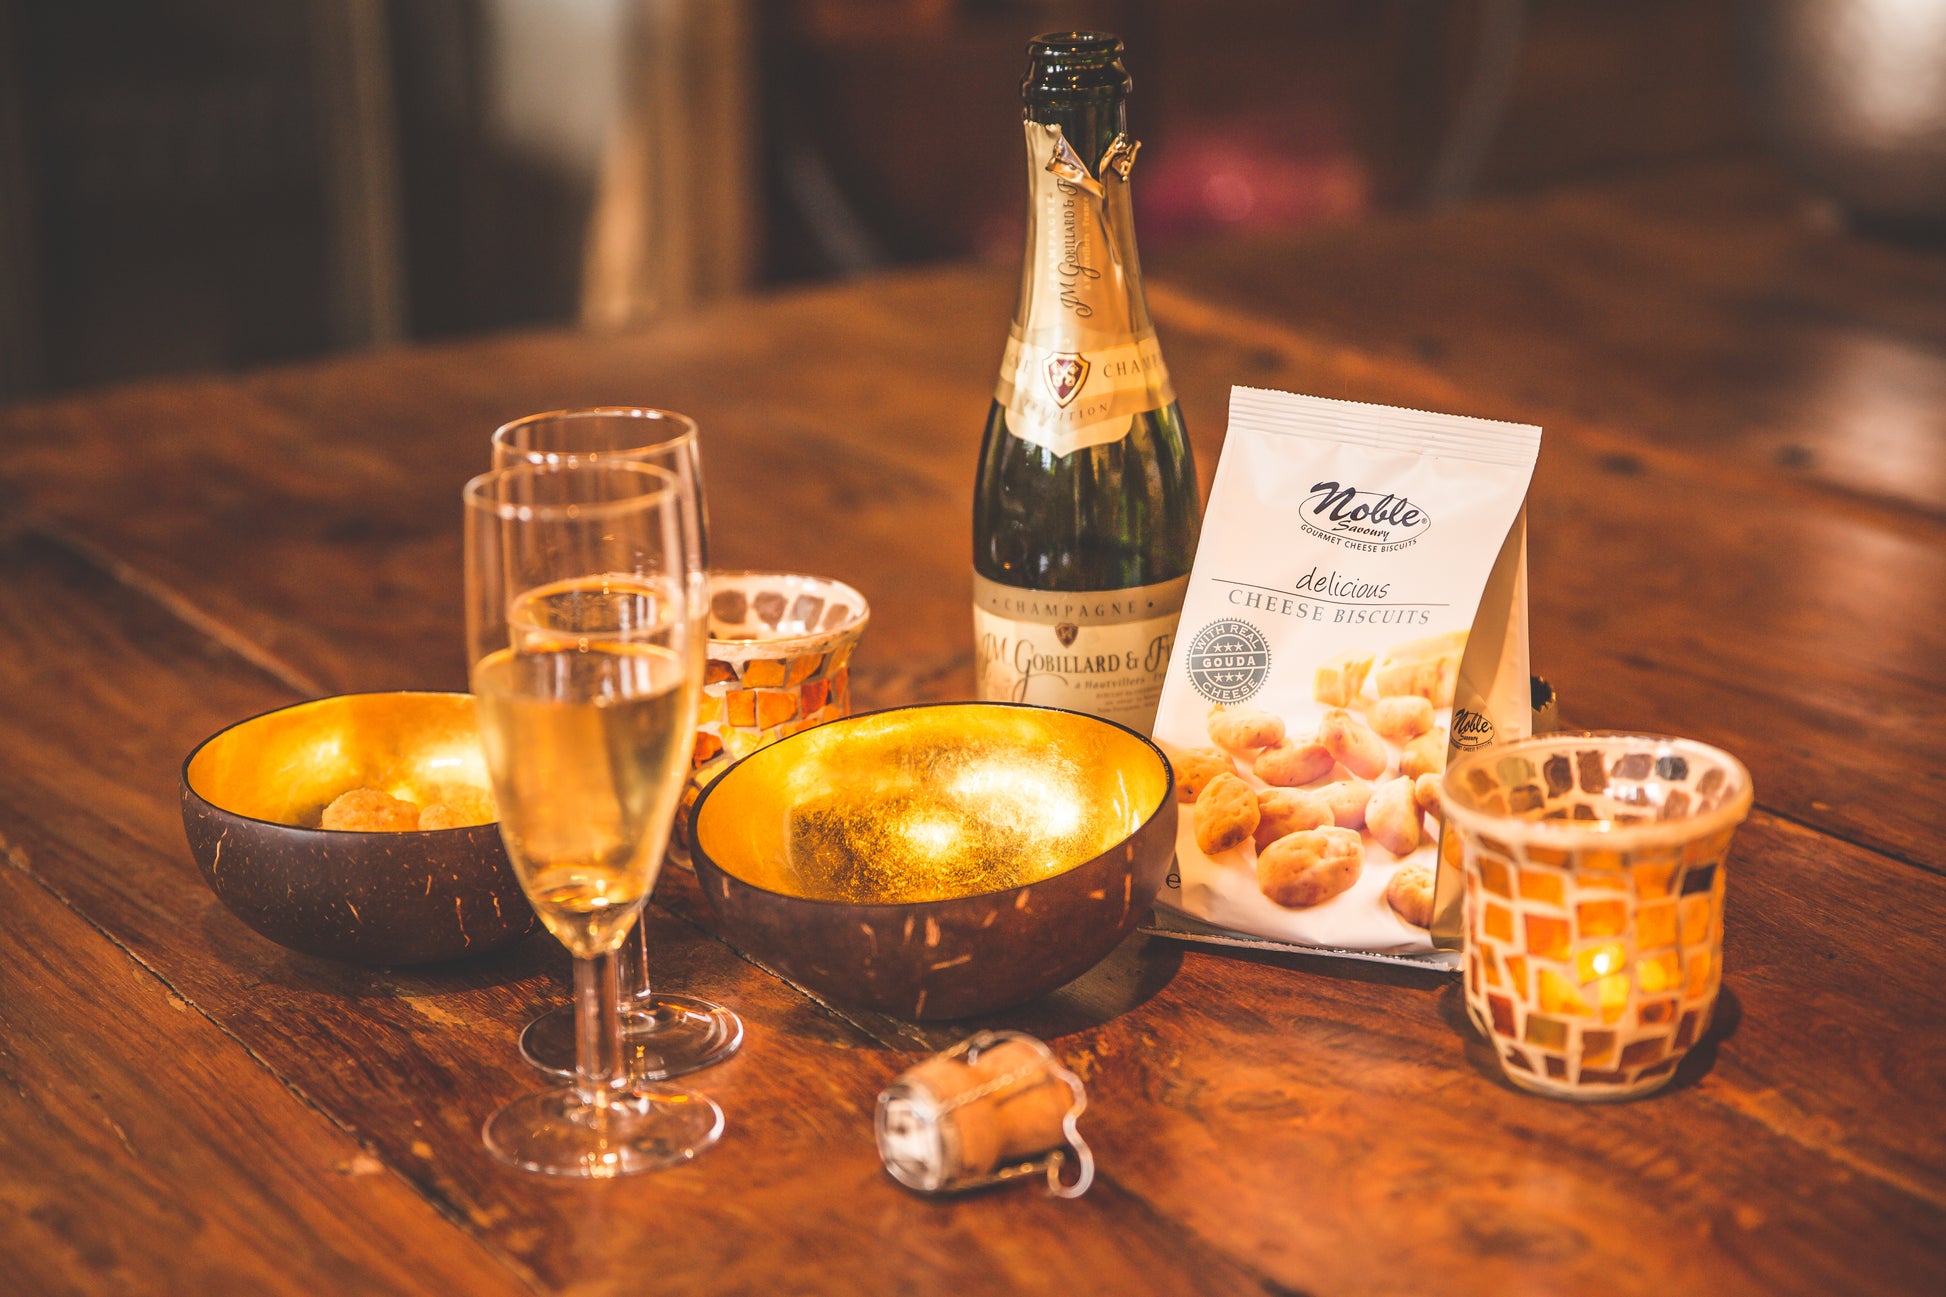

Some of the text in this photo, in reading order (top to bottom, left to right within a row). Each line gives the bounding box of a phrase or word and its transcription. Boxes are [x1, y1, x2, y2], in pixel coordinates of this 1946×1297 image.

[1300, 524, 1417, 553] GOURMET CHEESE BISCUITS
[1331, 520, 1391, 542] Savoury
[1295, 566, 1391, 599] delicious
[1004, 600, 1137, 617] CHAMPAGNE
[1228, 589, 1431, 625] CHEESE BISCUITS
[1197, 624, 1260, 652] WITH REAL
[1202, 655, 1257, 668] GOUDA
[1201, 678, 1258, 700] CHEESE
